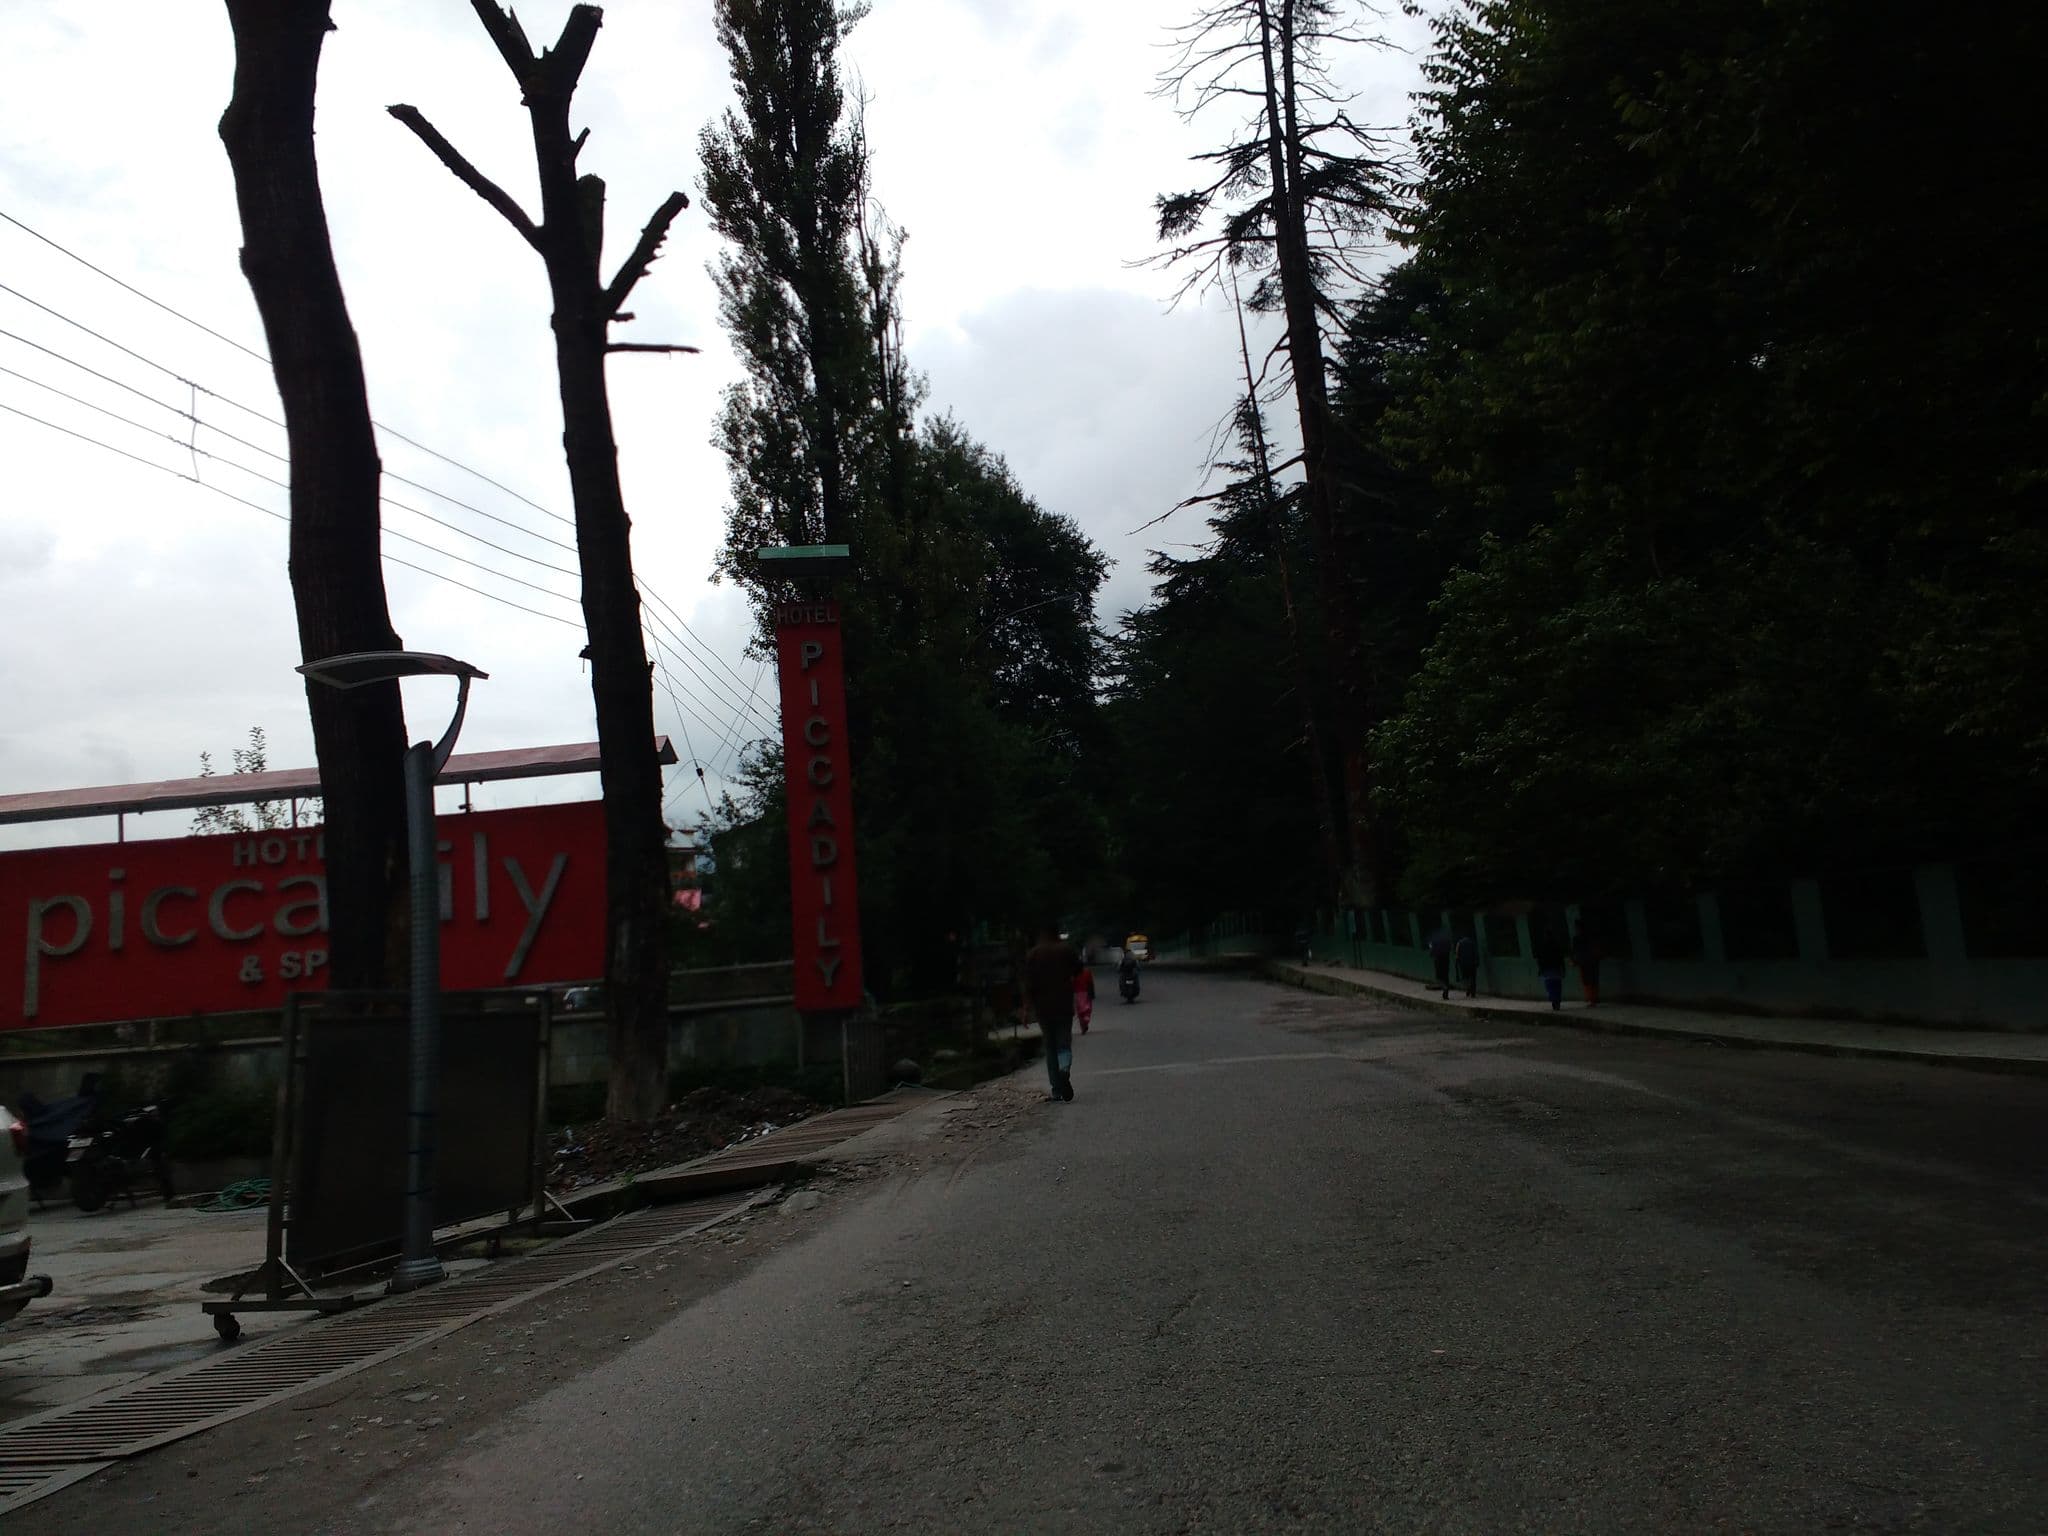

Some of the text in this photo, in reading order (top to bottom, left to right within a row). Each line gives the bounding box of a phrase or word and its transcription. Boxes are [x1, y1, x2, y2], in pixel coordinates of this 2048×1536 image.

[776, 605, 837, 625] HOTEL
[799, 638, 843, 989] PICCADILY
[232, 832, 328, 867] HOT
[22, 832, 569, 1018] piccaily
[239, 949, 330, 984] & SP
